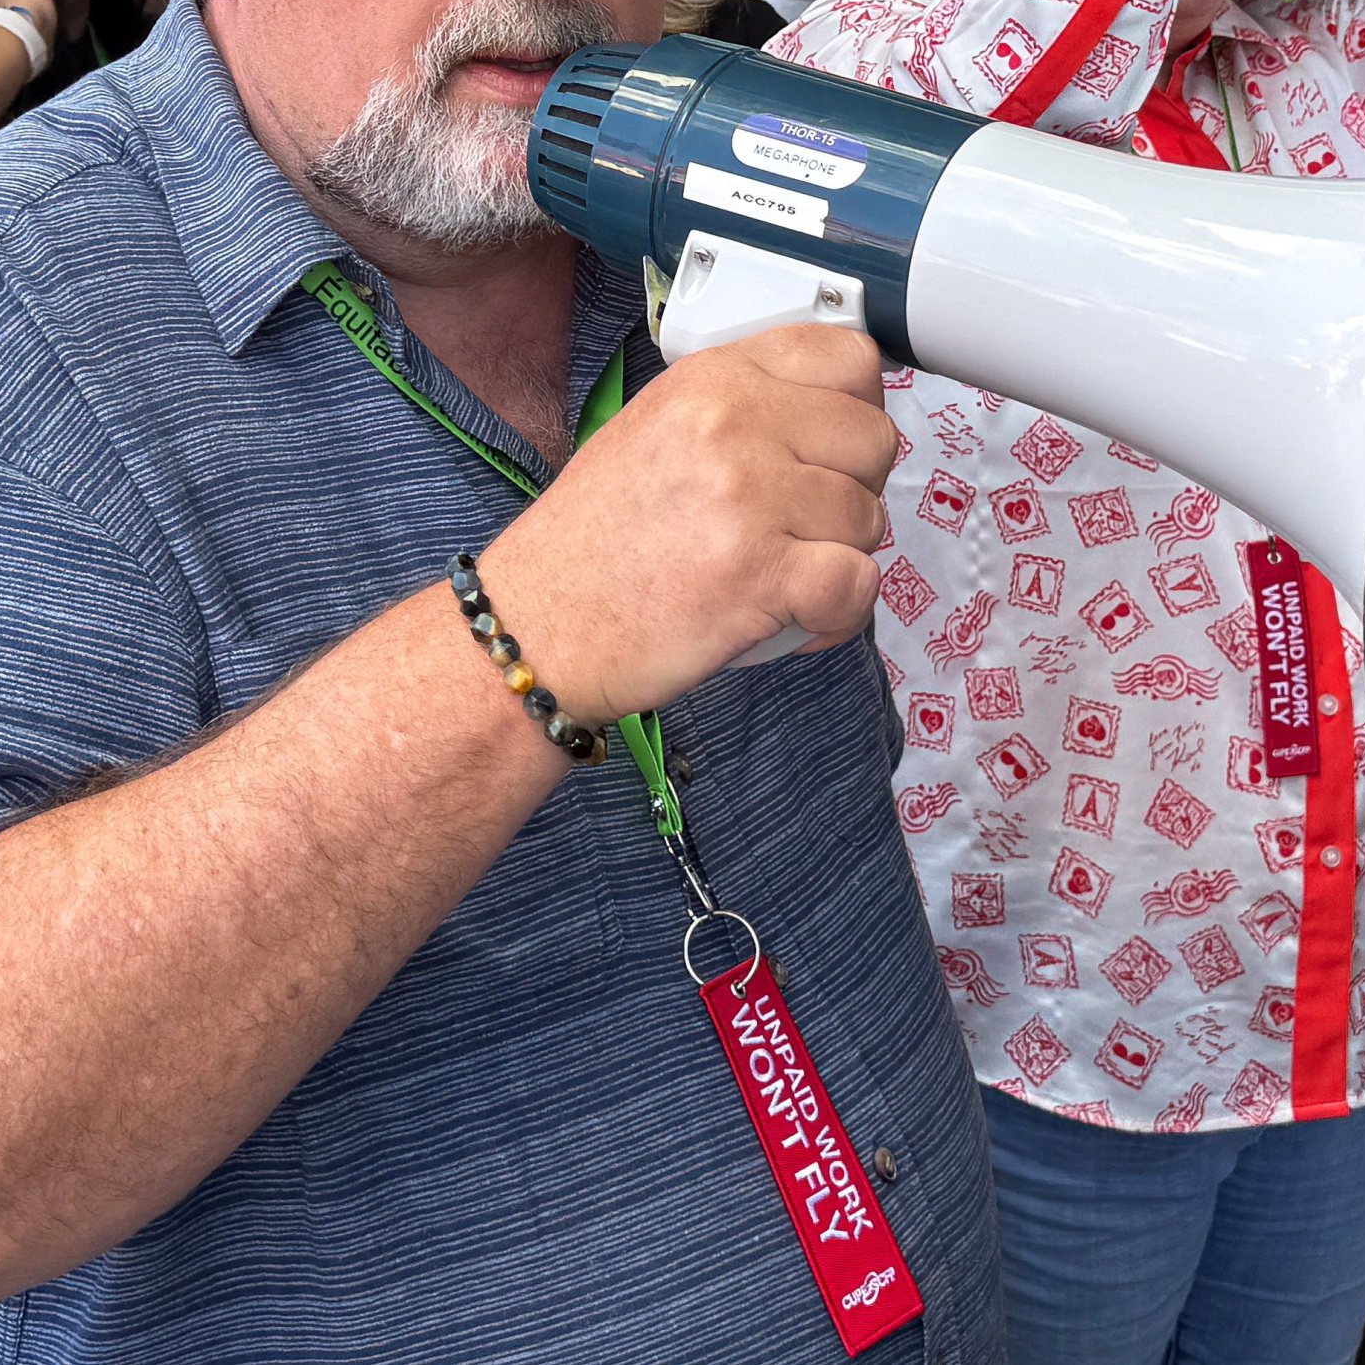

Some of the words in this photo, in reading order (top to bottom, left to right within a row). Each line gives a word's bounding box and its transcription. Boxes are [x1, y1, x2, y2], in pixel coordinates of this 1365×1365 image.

[752, 143, 838, 177] MEGAPHONE
[780, 122, 836, 147] THOR-15
[731, 191, 797, 216] ACC795
[1261, 583, 1289, 675] WON'T
[1282, 581, 1306, 661] UNPAID
[1268, 681, 1291, 726] FLY
[1290, 663, 1310, 728] WORK
[731, 1002, 811, 1150] WON'T
[794, 1161, 851, 1243] FLY
[754, 994, 819, 1122] UNPAID
[815, 1124, 875, 1241] WORK
